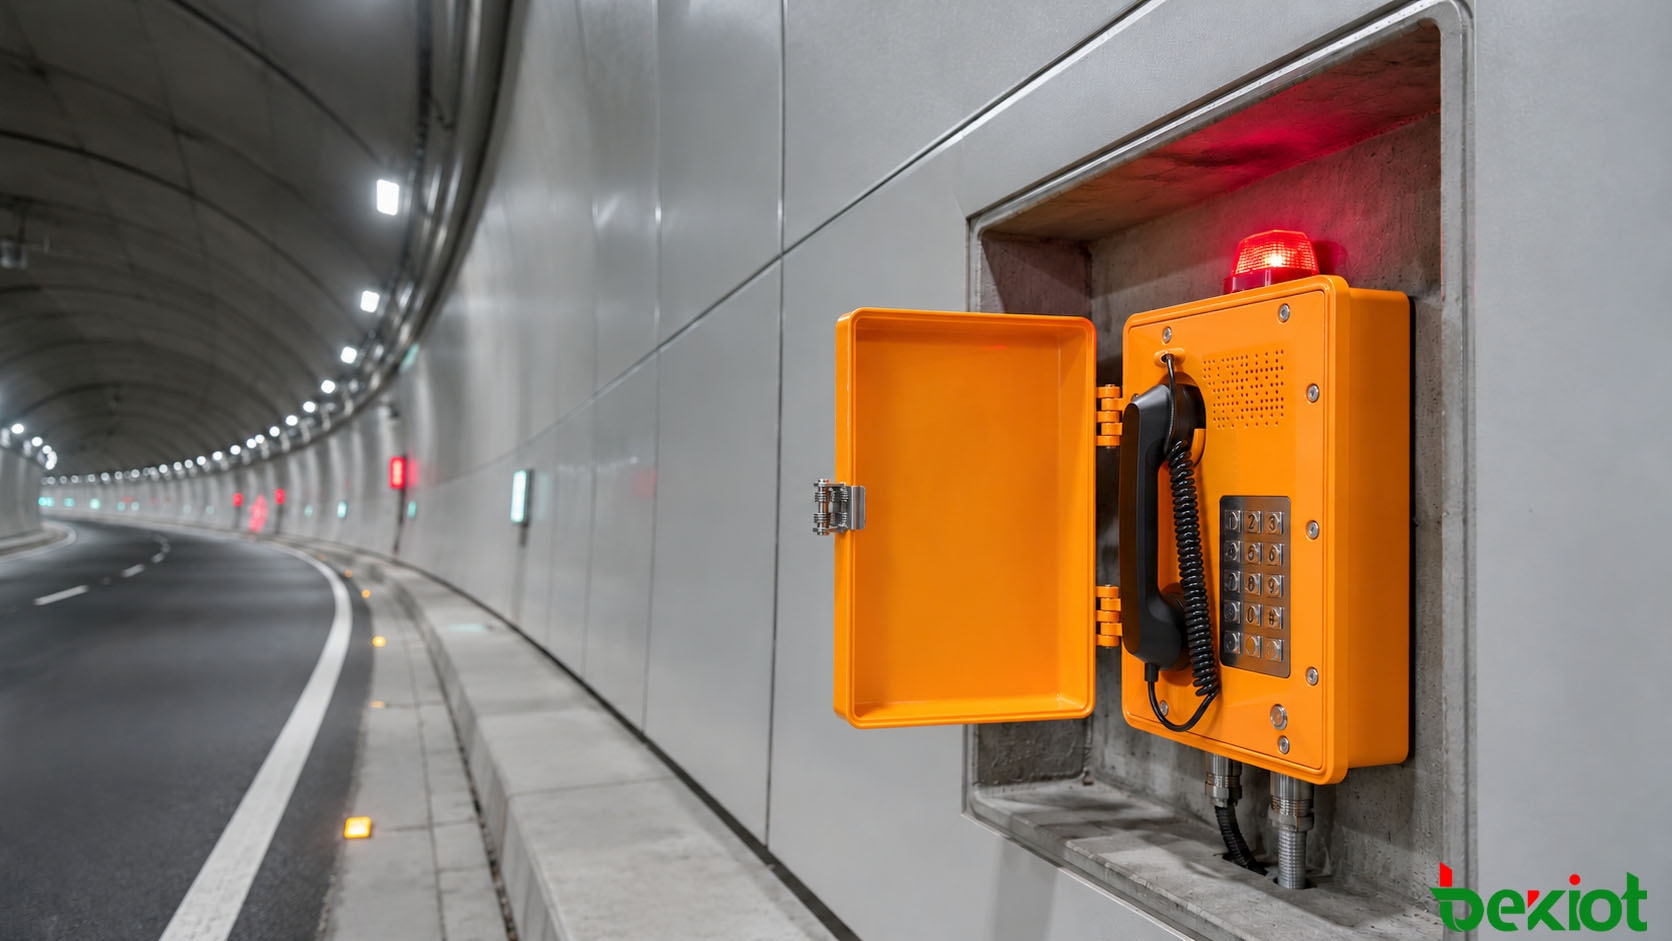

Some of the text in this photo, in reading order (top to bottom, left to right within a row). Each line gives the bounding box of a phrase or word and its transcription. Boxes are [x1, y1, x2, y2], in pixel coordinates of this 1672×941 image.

[1248, 514, 1255, 530] 2
[1268, 515, 1276, 531] 3
[1268, 545, 1275, 562] 6
[1247, 575, 1255, 592] 8
[1267, 577, 1275, 594] 9
[1247, 606, 1254, 623] 0
